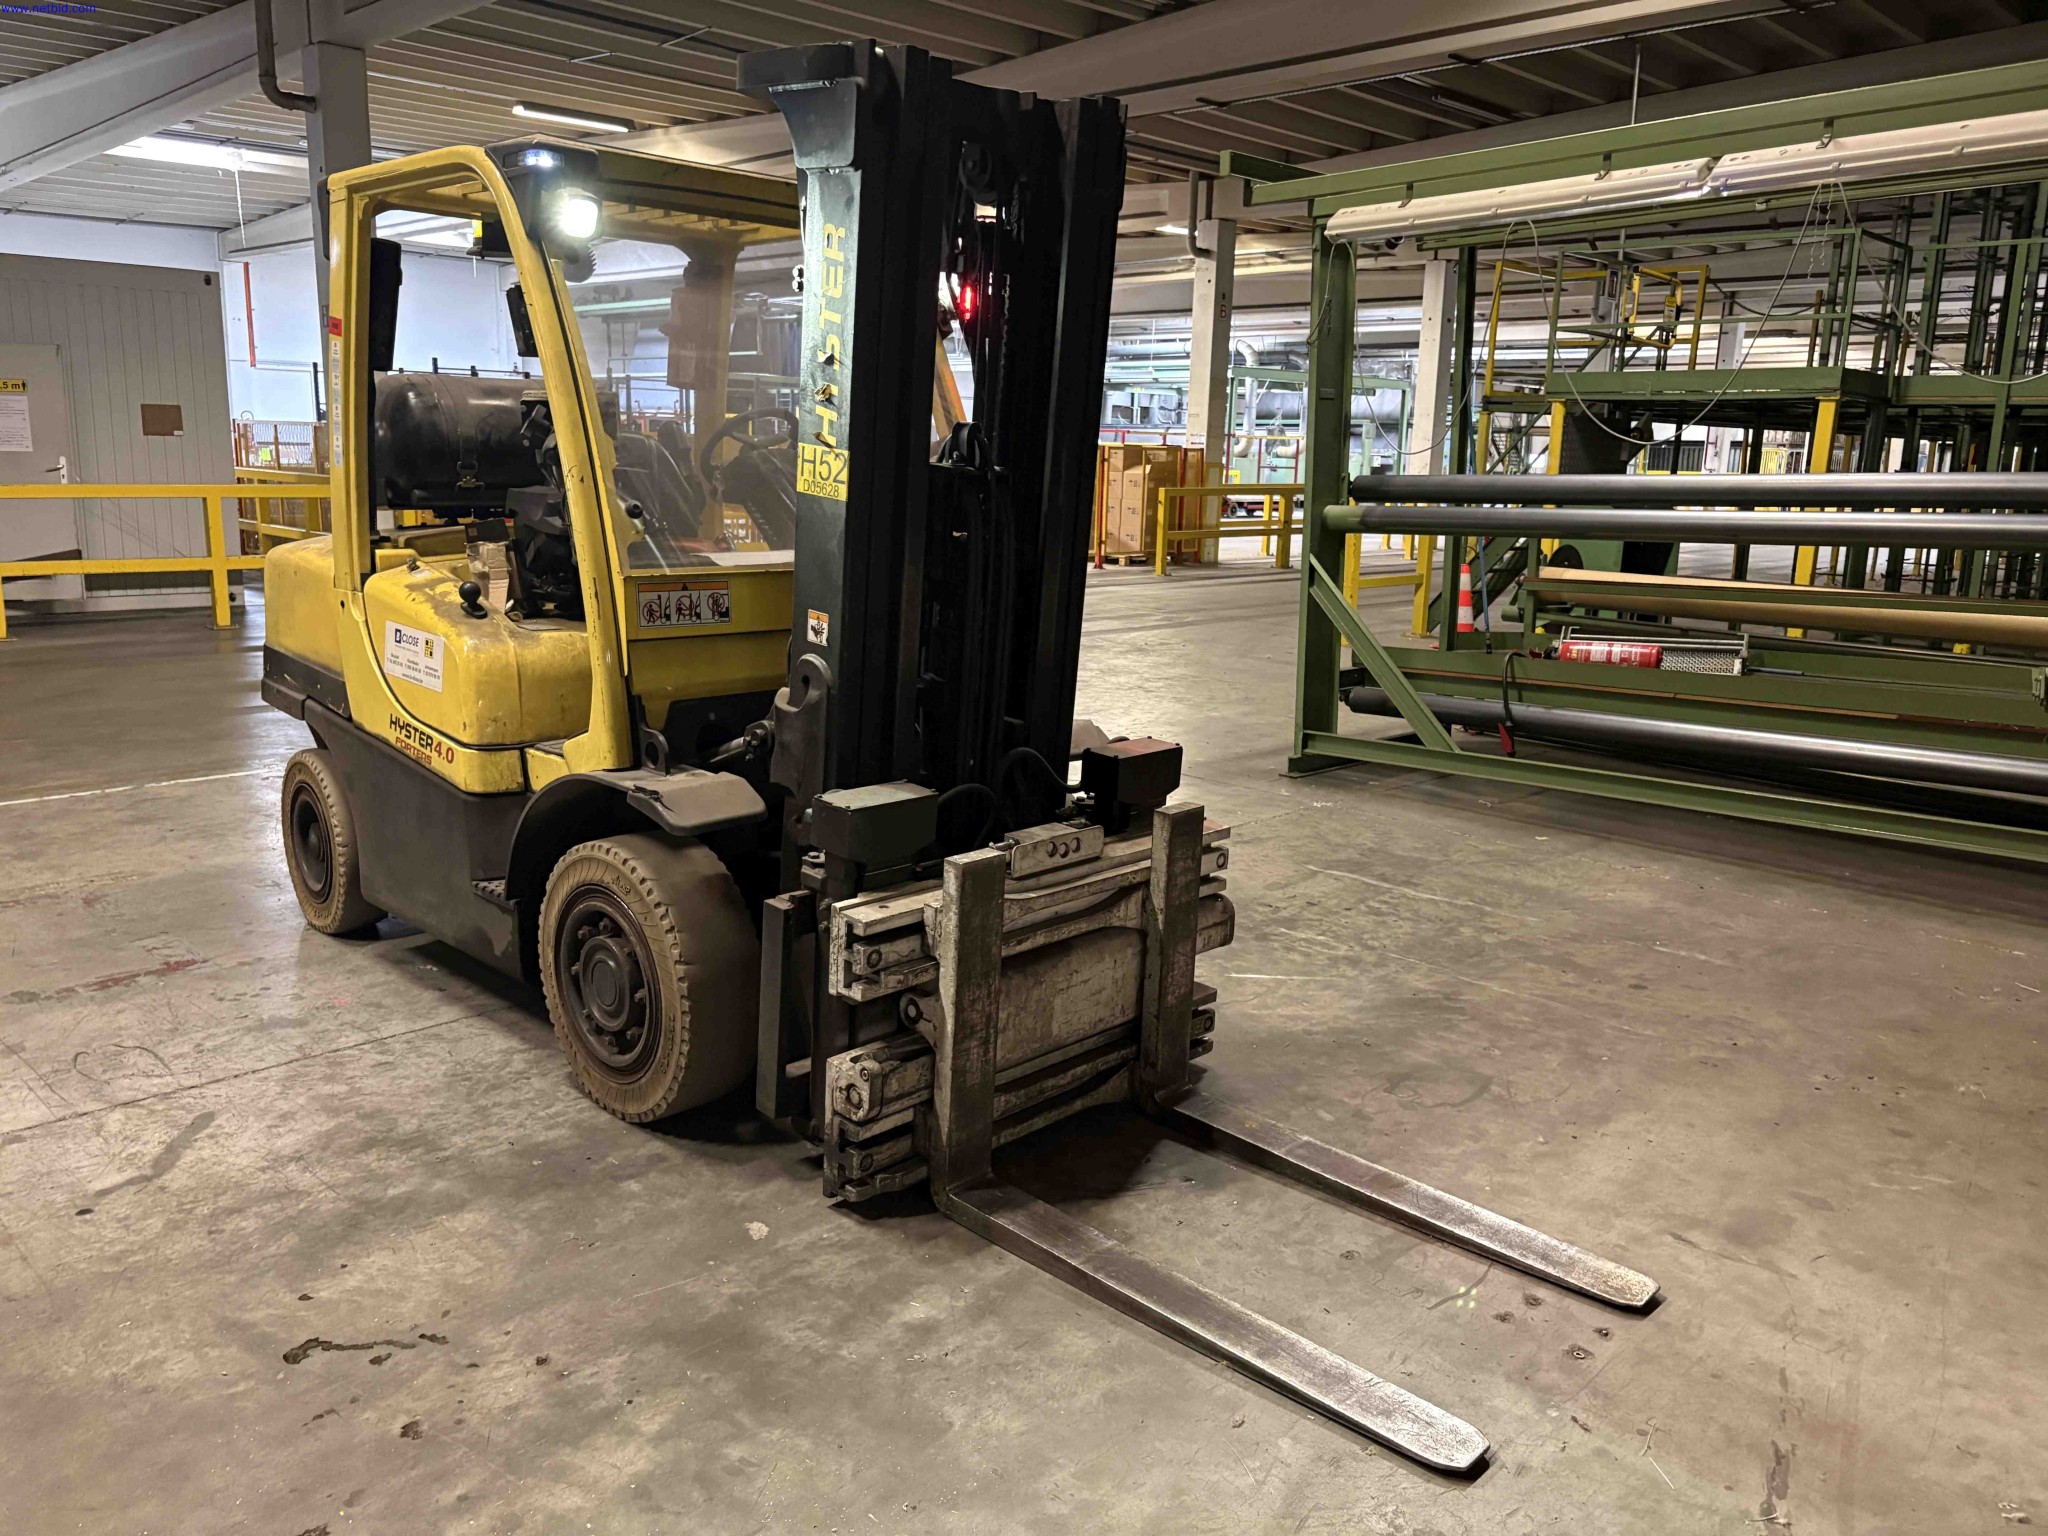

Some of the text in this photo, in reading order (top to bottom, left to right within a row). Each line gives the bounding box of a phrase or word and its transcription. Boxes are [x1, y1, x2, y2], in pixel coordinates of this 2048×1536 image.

[814, 223, 846, 447] HSTER
[801, 446, 847, 485] H52
[803, 479, 840, 498] D05628
[389, 713, 455, 765] HYSTER 4.0
